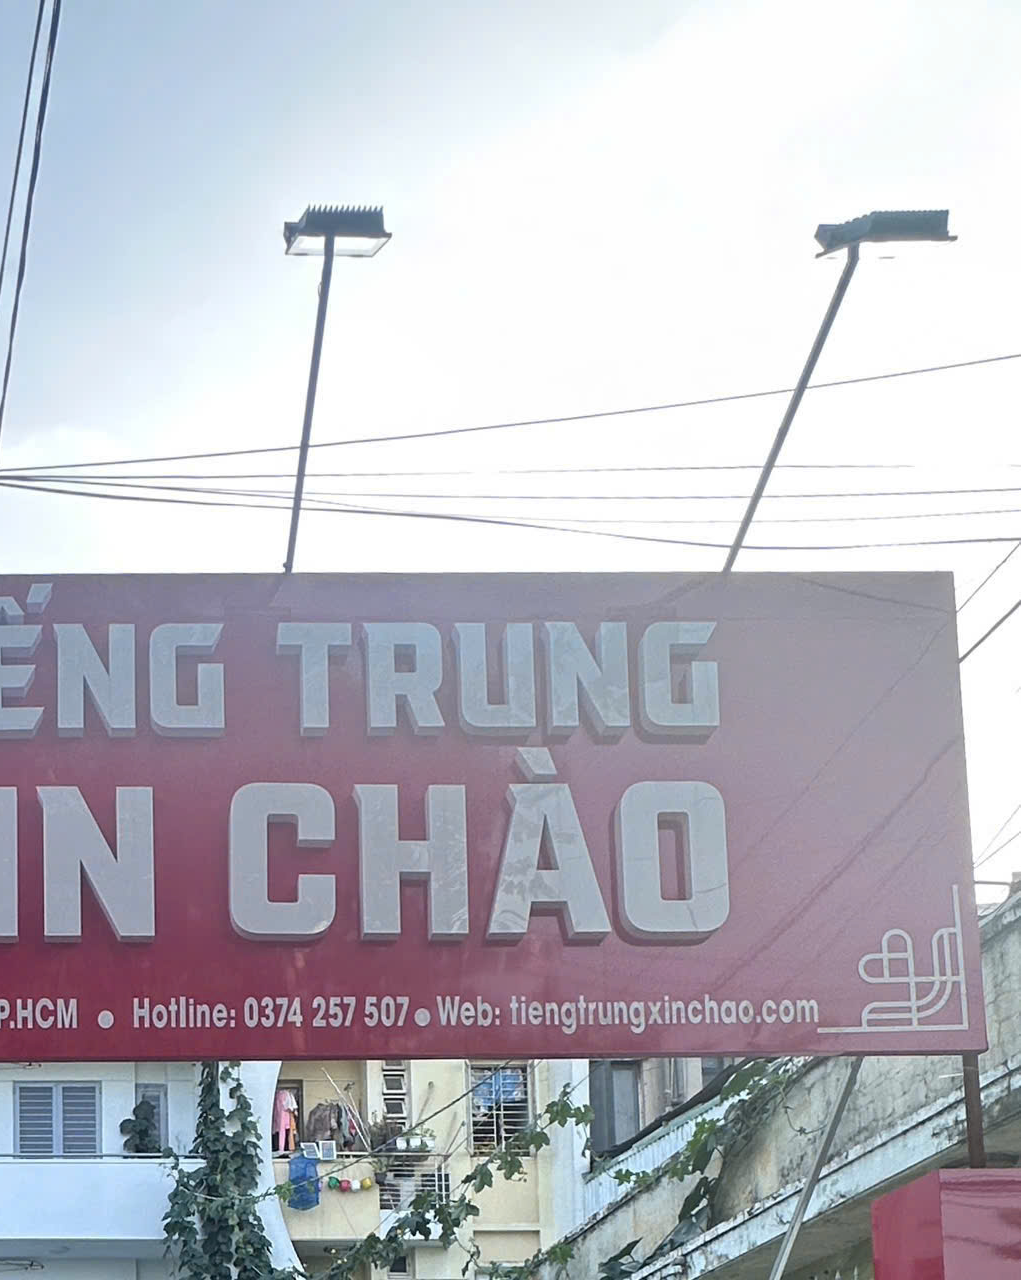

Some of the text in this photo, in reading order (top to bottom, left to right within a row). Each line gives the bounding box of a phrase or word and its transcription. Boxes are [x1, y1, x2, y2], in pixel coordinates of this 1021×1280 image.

[276, 621, 720, 741] TRUNG
[229, 747, 730, 946] CHÀO
[133, 996, 410, 1029] Hotline: 0374 257 507
[436, 994, 820, 1034] Web: tiengtrungxinchao.com
